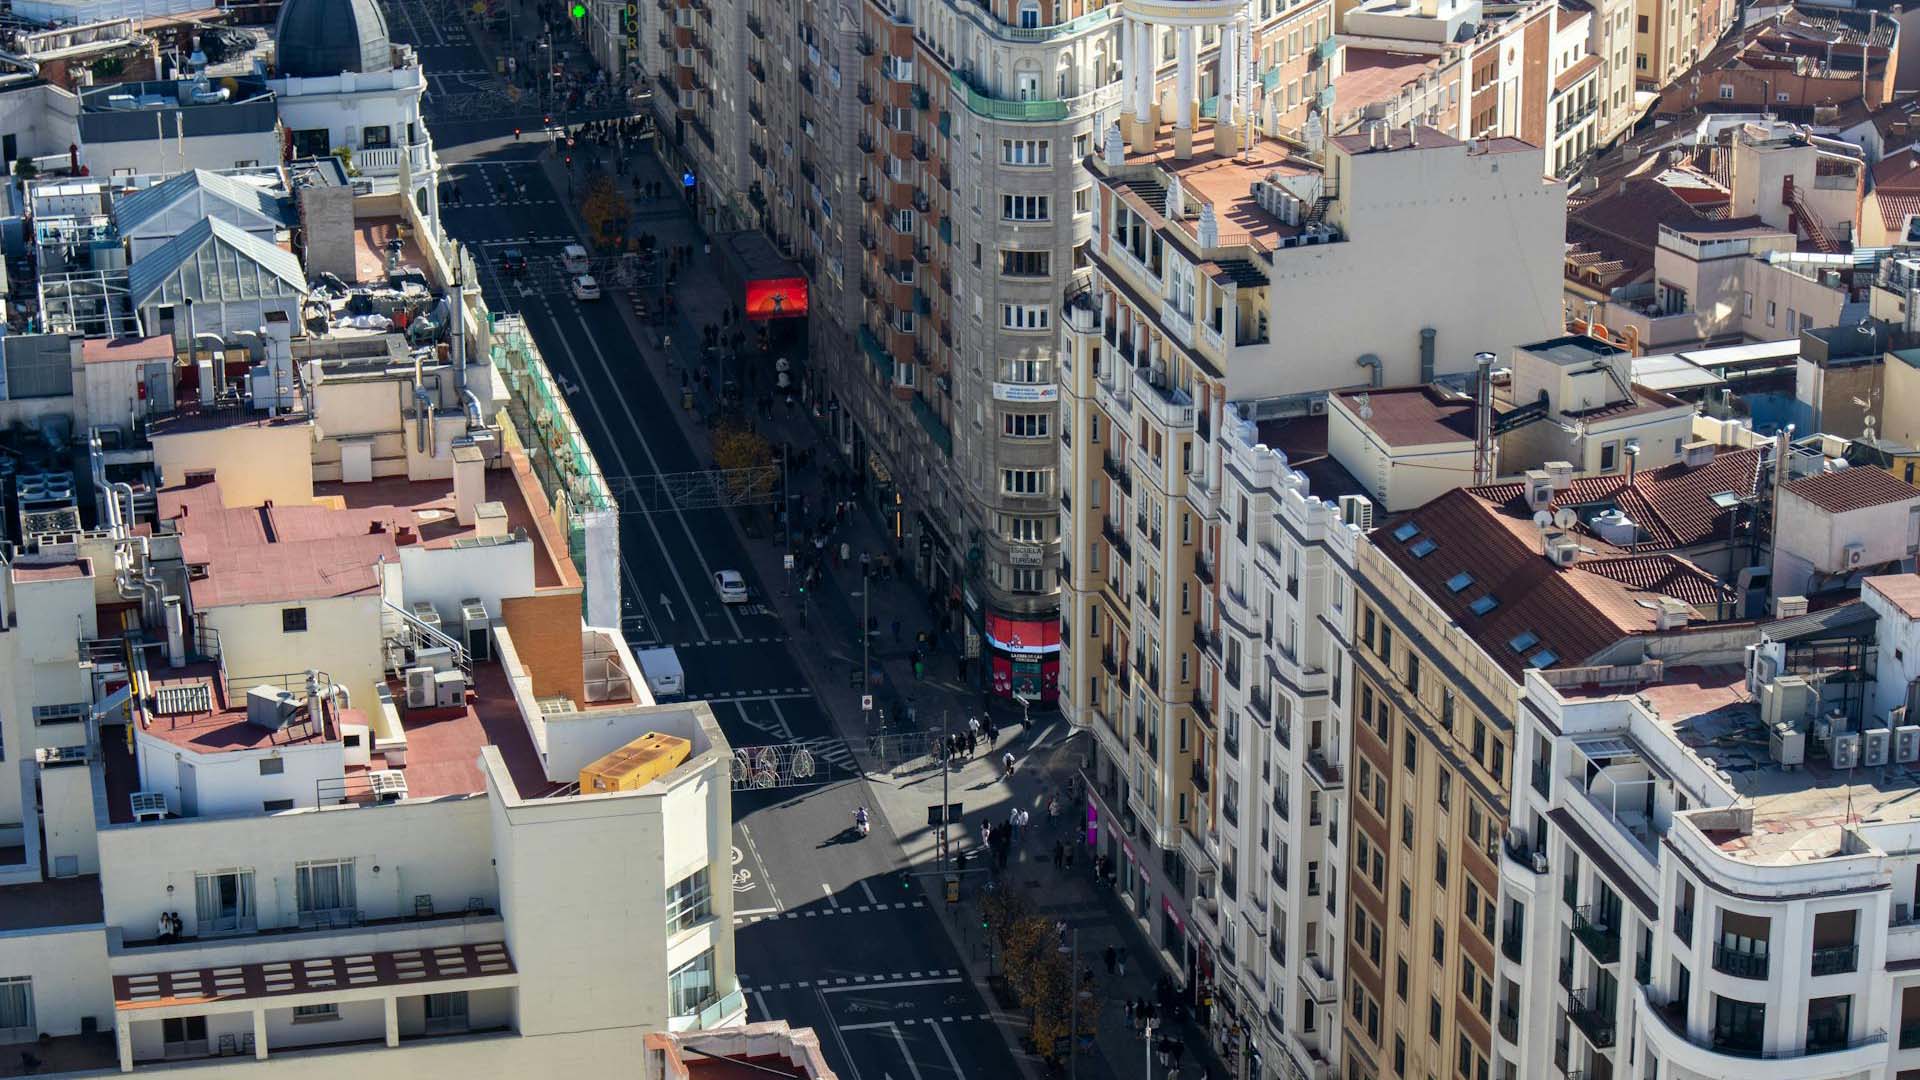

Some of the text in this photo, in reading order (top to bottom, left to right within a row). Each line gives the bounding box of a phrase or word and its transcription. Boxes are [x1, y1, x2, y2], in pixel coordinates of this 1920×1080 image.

[1009, 545, 1042, 555] ESCUELA
[1010, 556, 1041, 564] TURISMO
[739, 604, 767, 616] BUS
